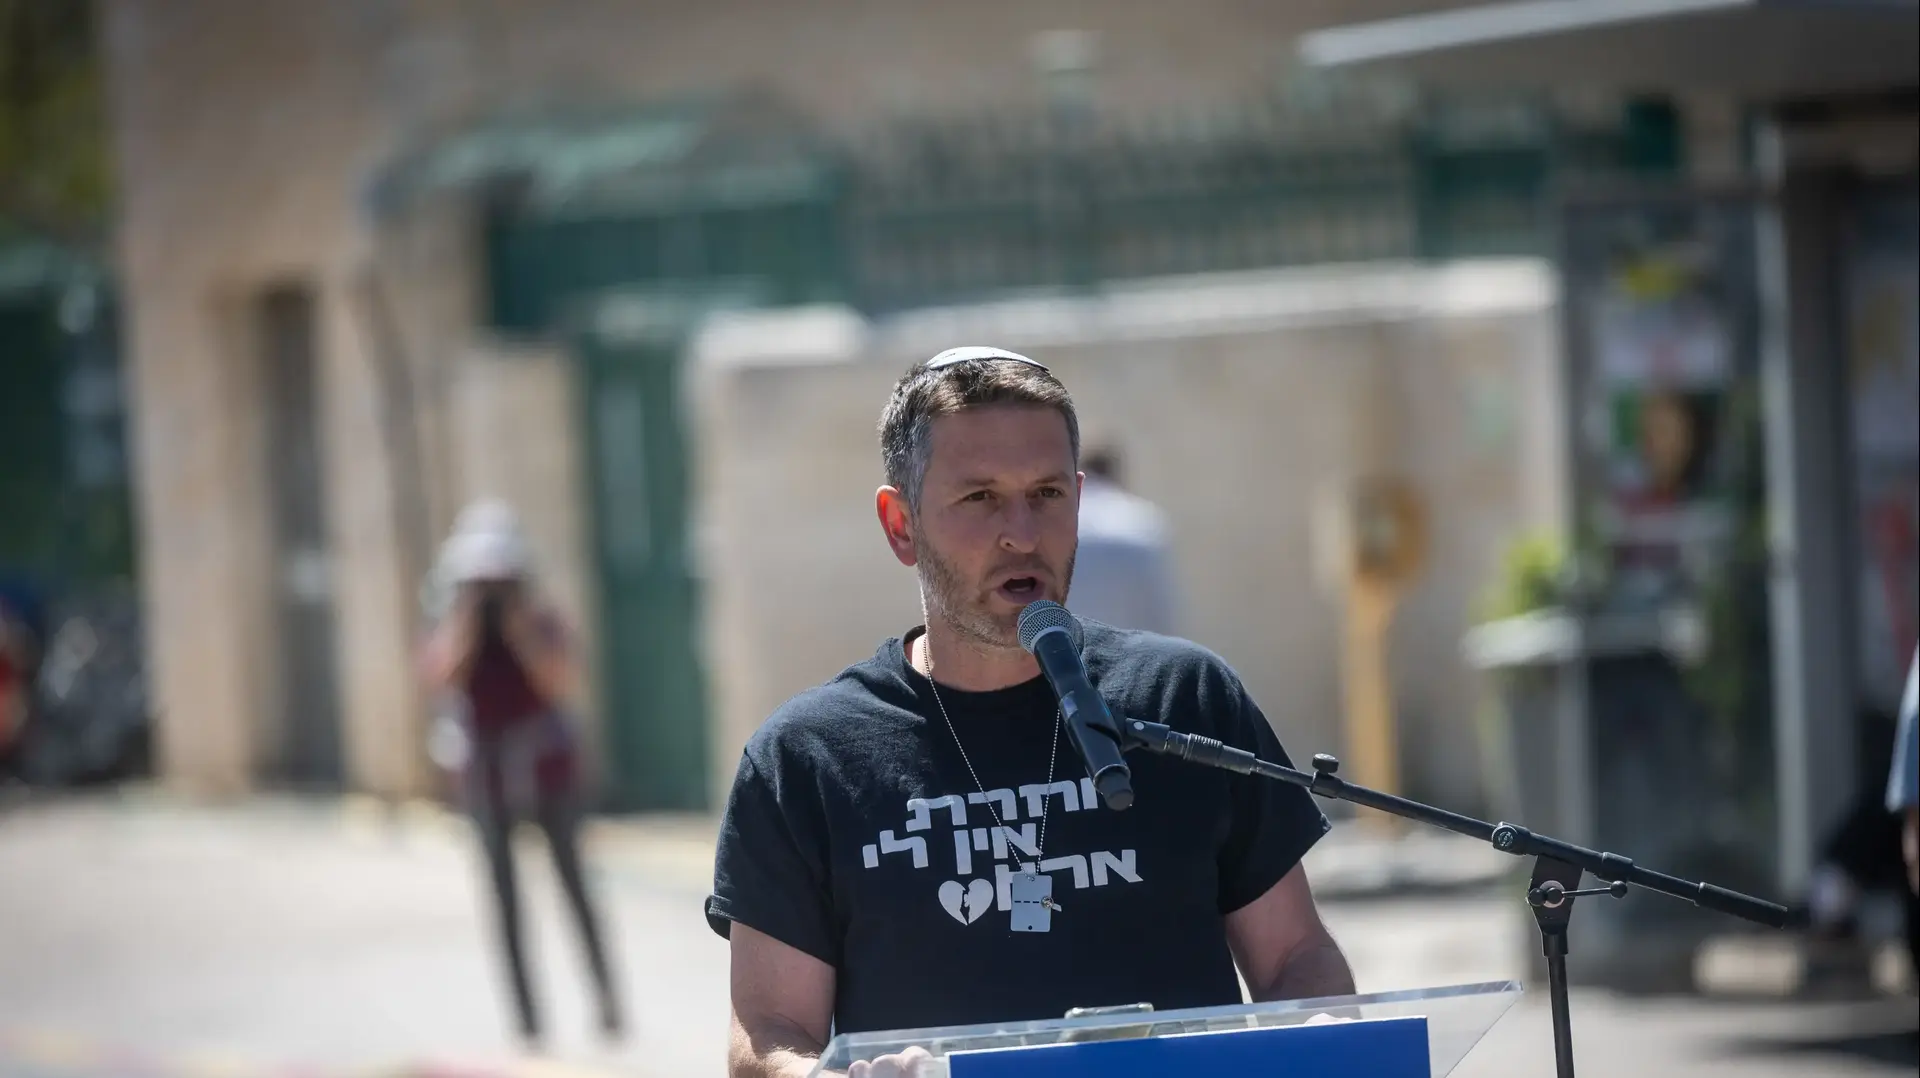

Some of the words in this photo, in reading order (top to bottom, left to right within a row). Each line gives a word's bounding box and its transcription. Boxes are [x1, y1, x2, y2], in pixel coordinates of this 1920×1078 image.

[862, 829, 929, 869] לי
[953, 822, 1044, 875] אין
[993, 849, 1144, 912] ארץ
